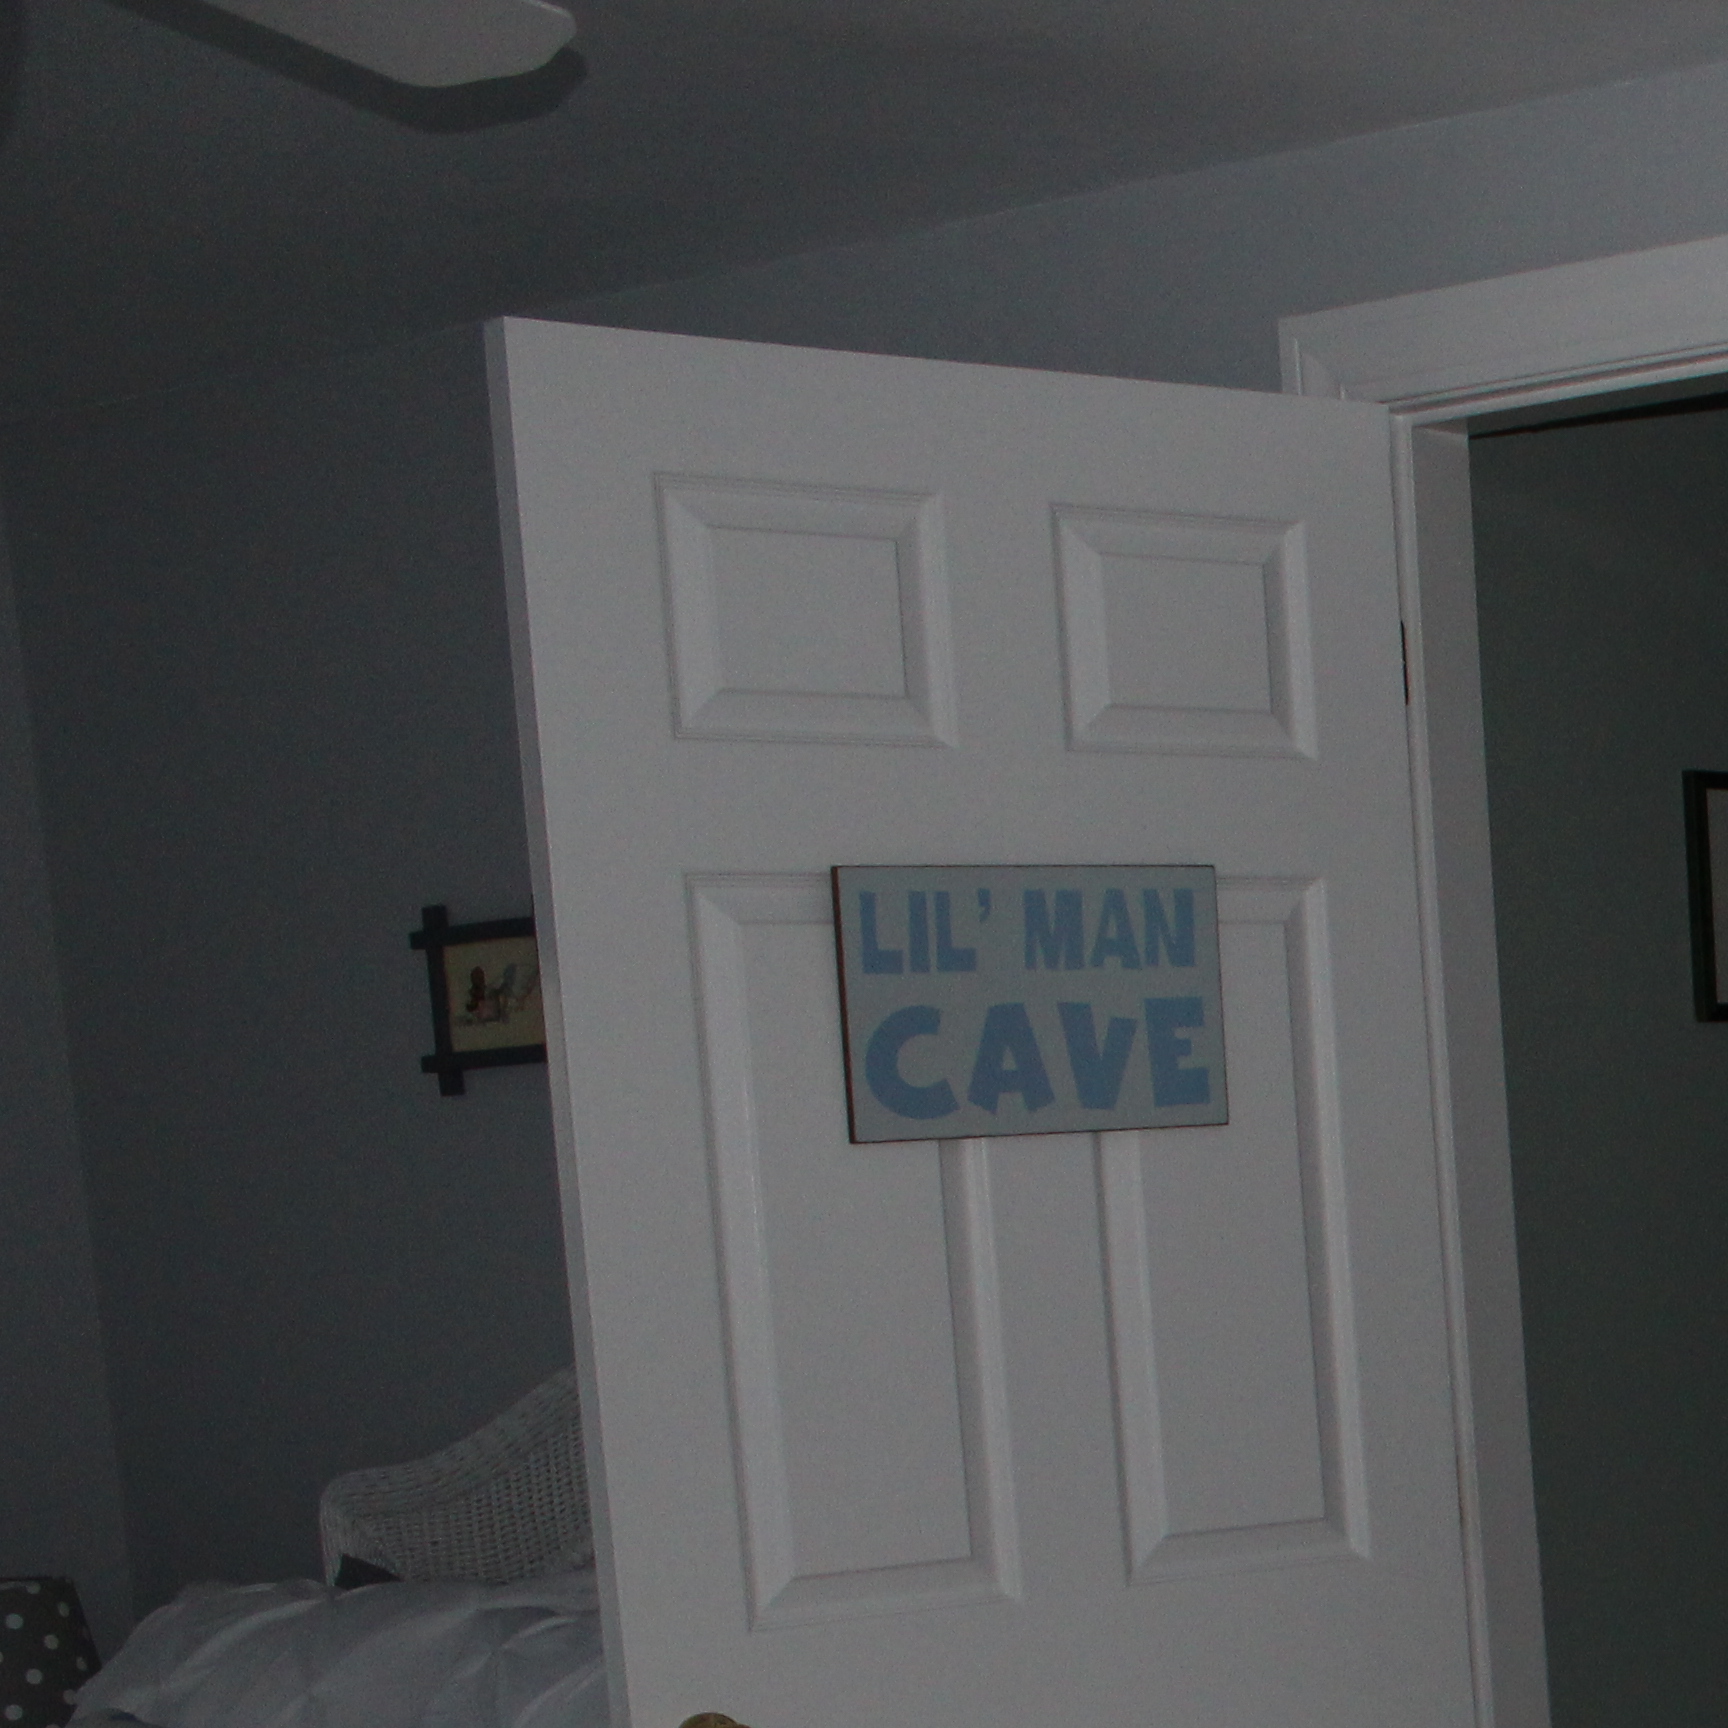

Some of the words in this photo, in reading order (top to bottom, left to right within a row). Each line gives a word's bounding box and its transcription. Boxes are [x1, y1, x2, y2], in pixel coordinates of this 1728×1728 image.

[858, 888, 991, 975] LIL'
[1023, 887, 1196, 971] MAN
[865, 996, 1211, 1120] CAVE
